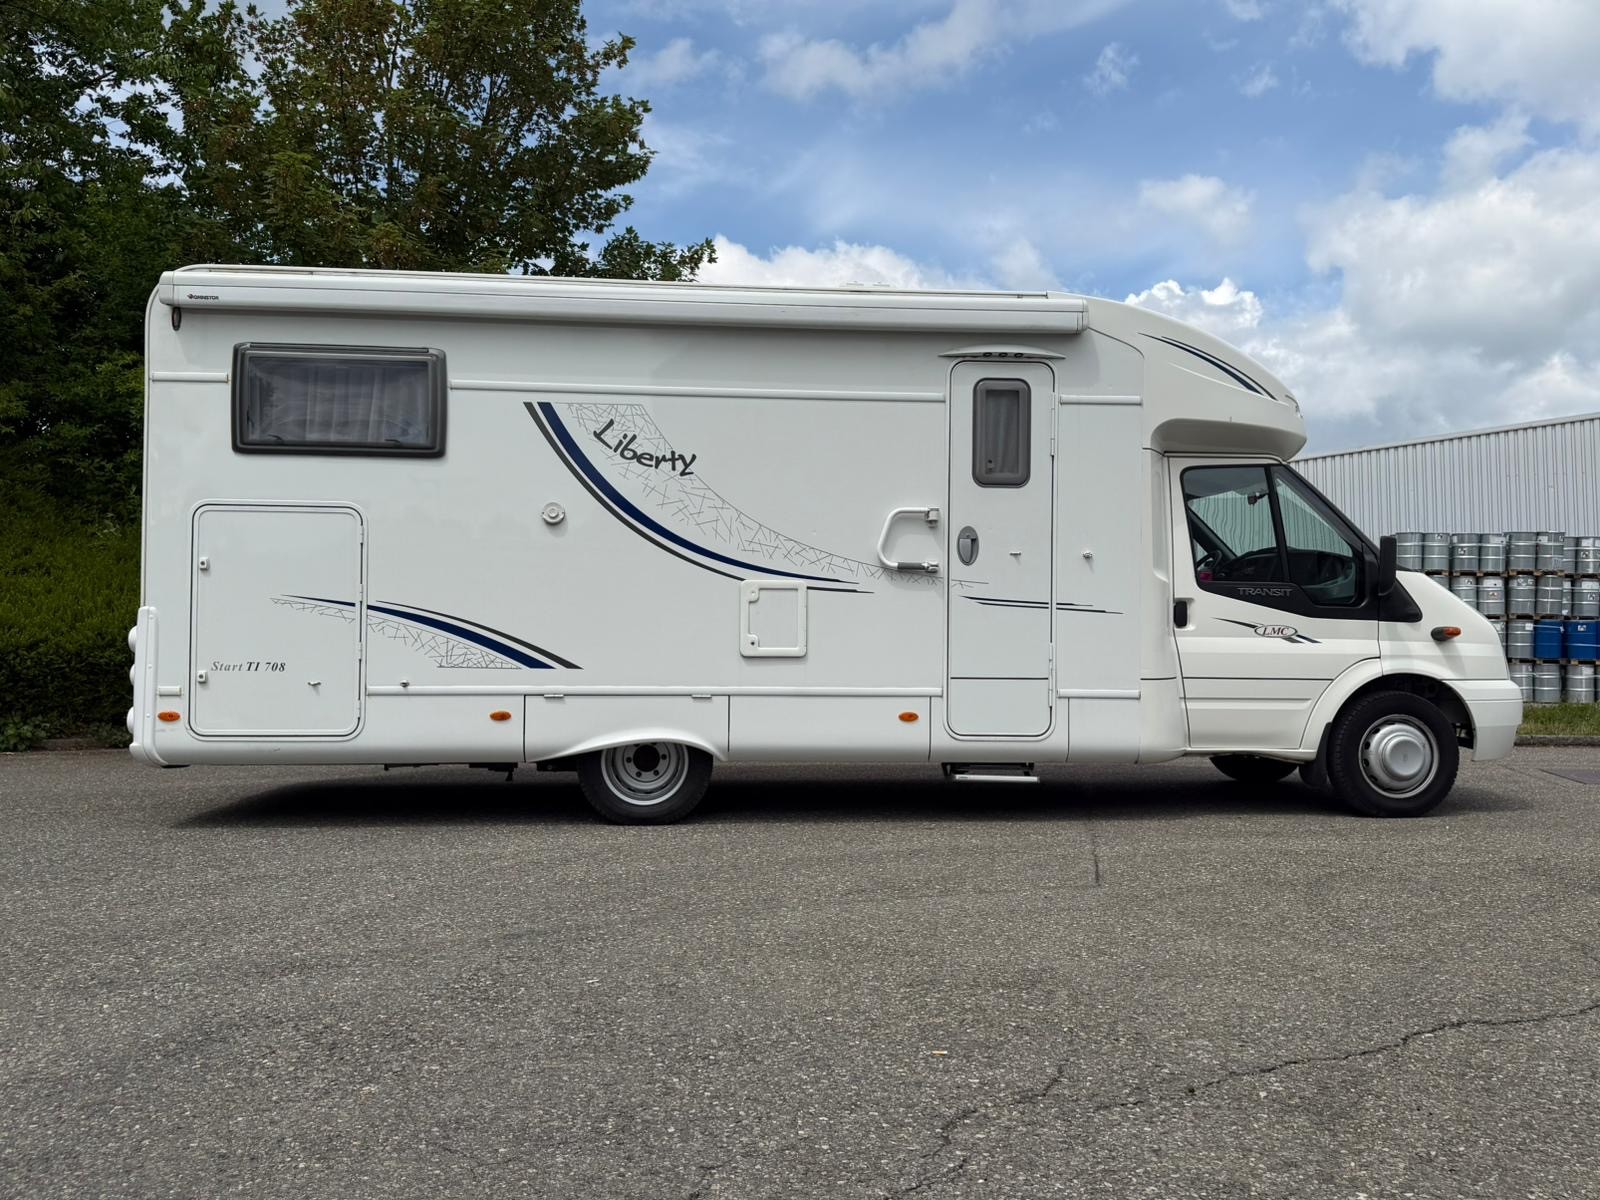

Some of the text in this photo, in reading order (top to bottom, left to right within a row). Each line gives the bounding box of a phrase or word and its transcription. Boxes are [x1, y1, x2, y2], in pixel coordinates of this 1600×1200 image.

[593, 418, 697, 477] Liberty
[1237, 587, 1294, 597] TRANSIT
[1262, 627, 1290, 636] LMC
[211, 661, 286, 672] Start TI 708
